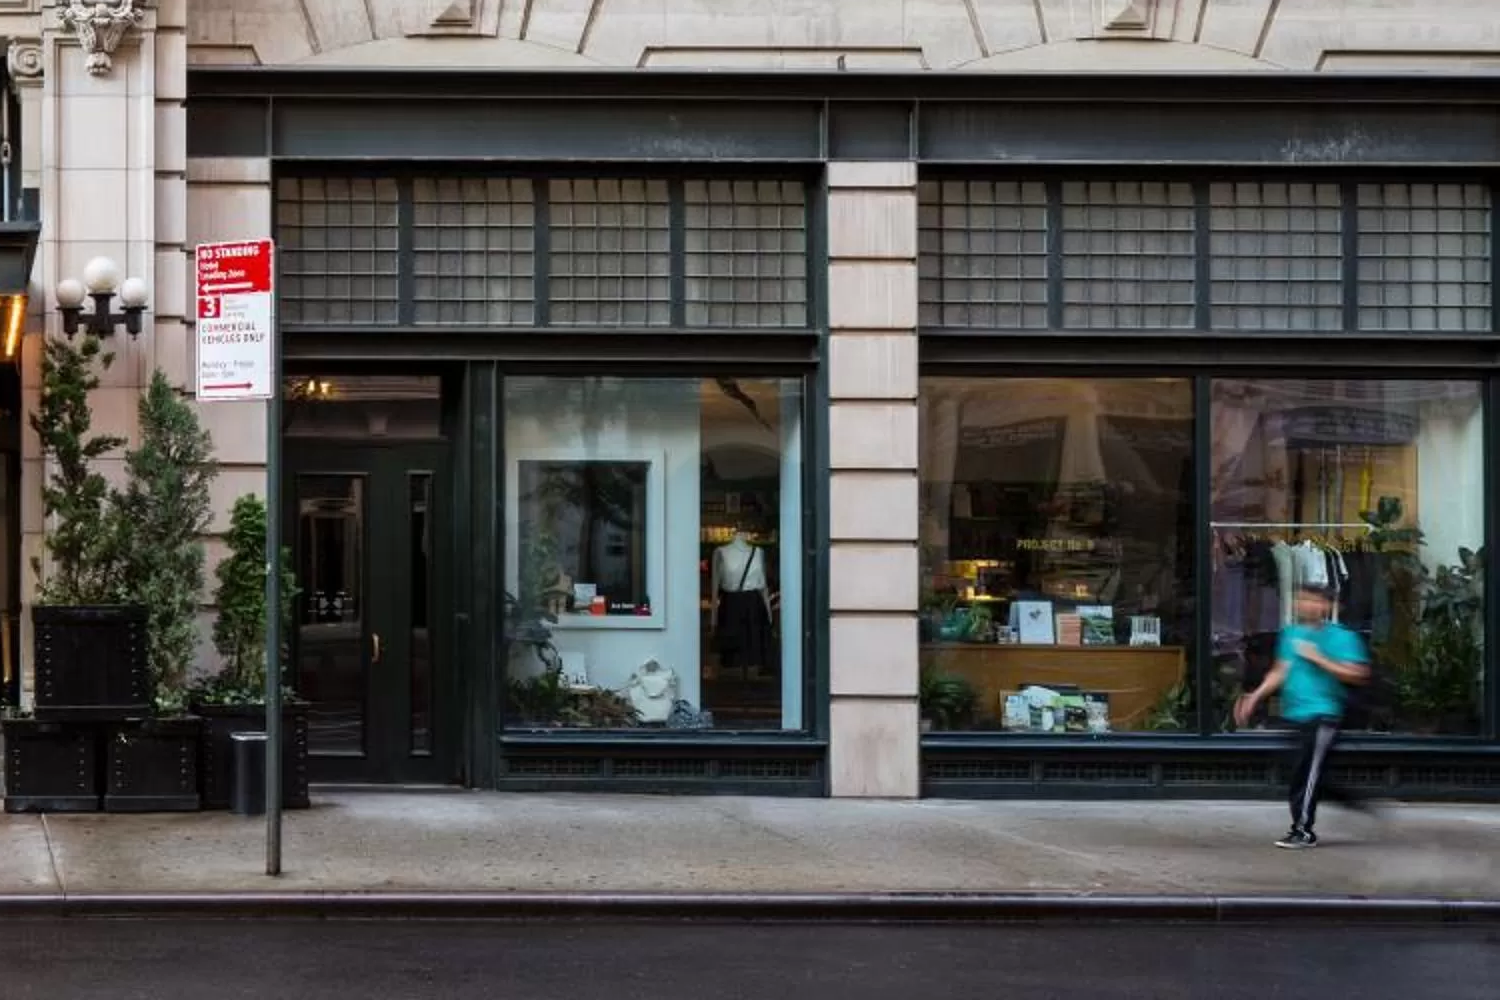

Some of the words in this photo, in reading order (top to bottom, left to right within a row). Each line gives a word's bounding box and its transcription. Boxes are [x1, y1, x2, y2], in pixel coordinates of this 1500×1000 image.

[199, 249, 213, 260] NO
[215, 245, 260, 259] STANDING
[203, 297, 216, 316] 3
[202, 321, 256, 333] COMMERCIAL
[202, 333, 241, 345] VEHICLES
[243, 332, 265, 343] ONLY
